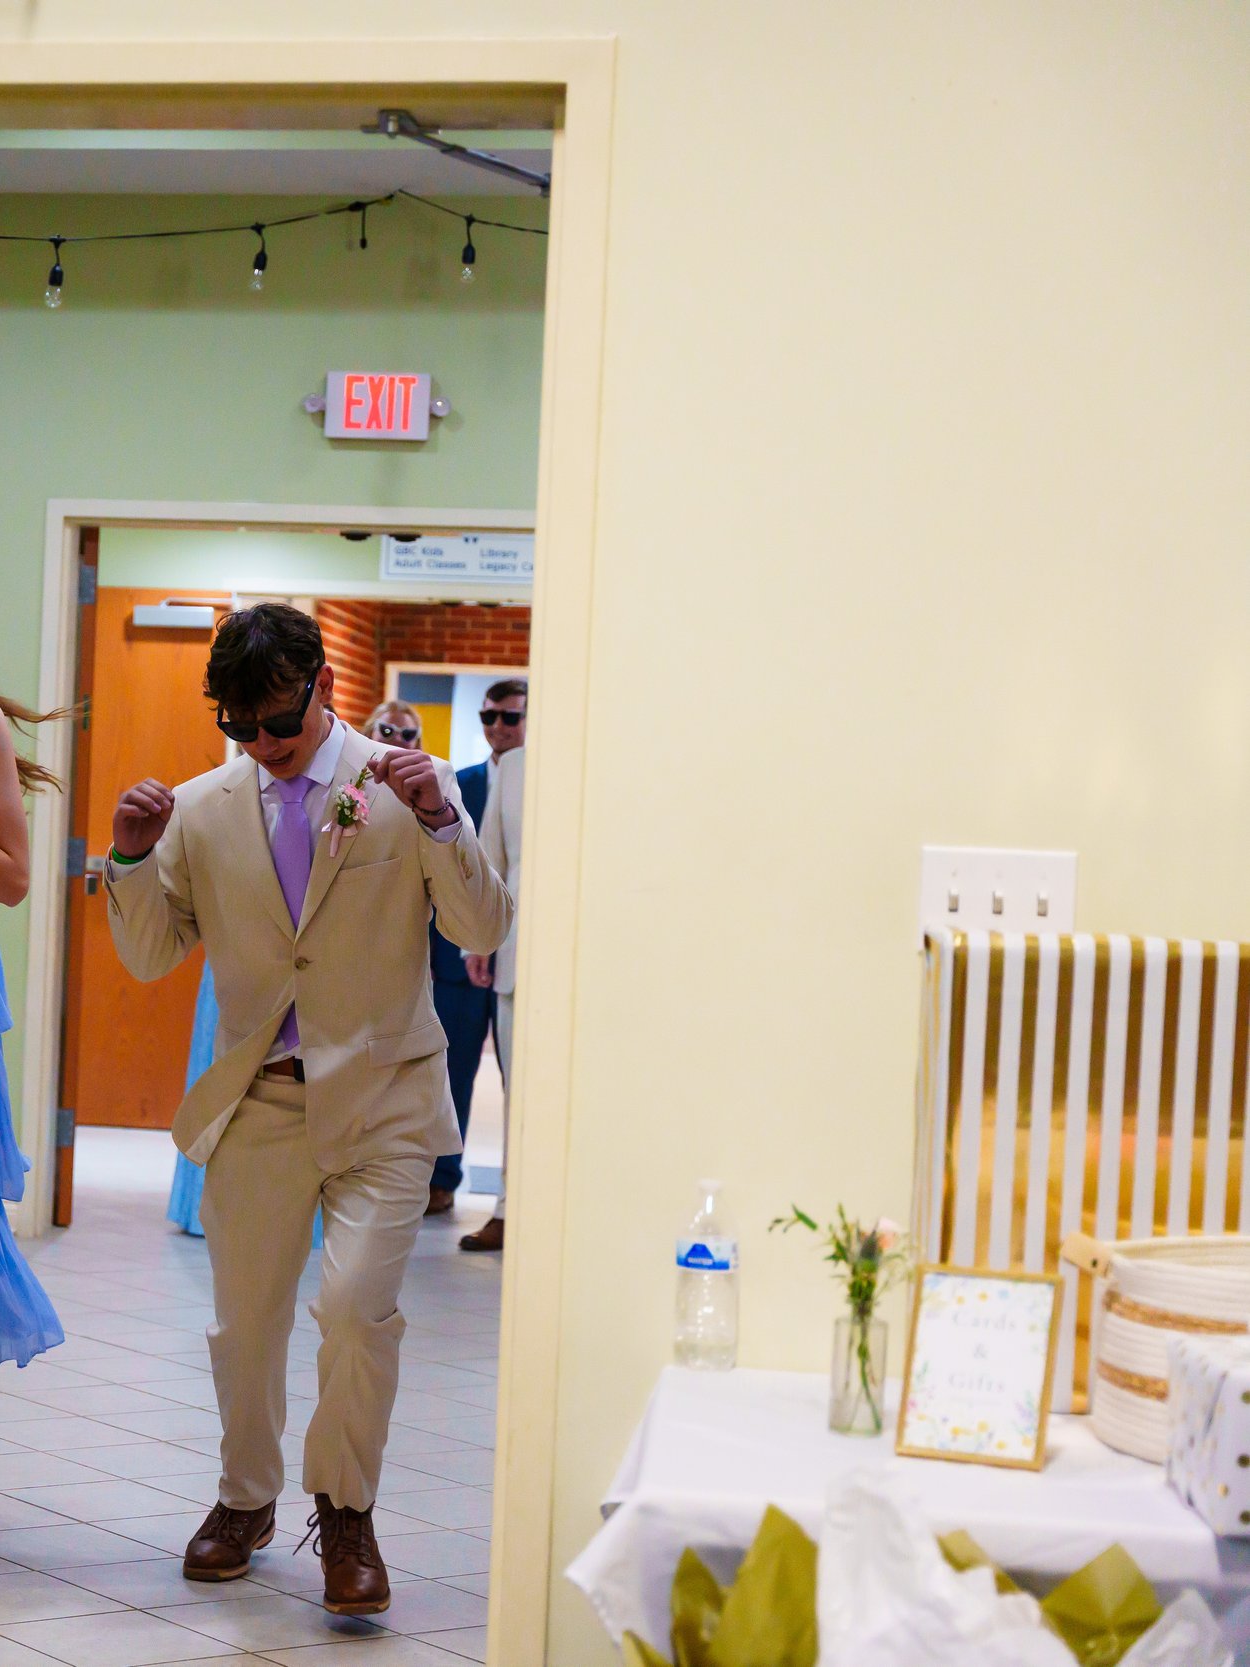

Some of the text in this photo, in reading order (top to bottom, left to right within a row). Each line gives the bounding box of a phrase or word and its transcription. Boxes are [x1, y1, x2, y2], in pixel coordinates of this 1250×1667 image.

[343, 373, 418, 433] EXIT
[422, 547, 444, 556] Kids
[480, 549, 518, 559] Library
[395, 559, 466, 569] Adult Classes
[480, 561, 517, 572] Legacy
[952, 1312, 1016, 1330] Cards
[973, 1343, 987, 1359] &
[949, 1373, 1005, 1392] Gifts
